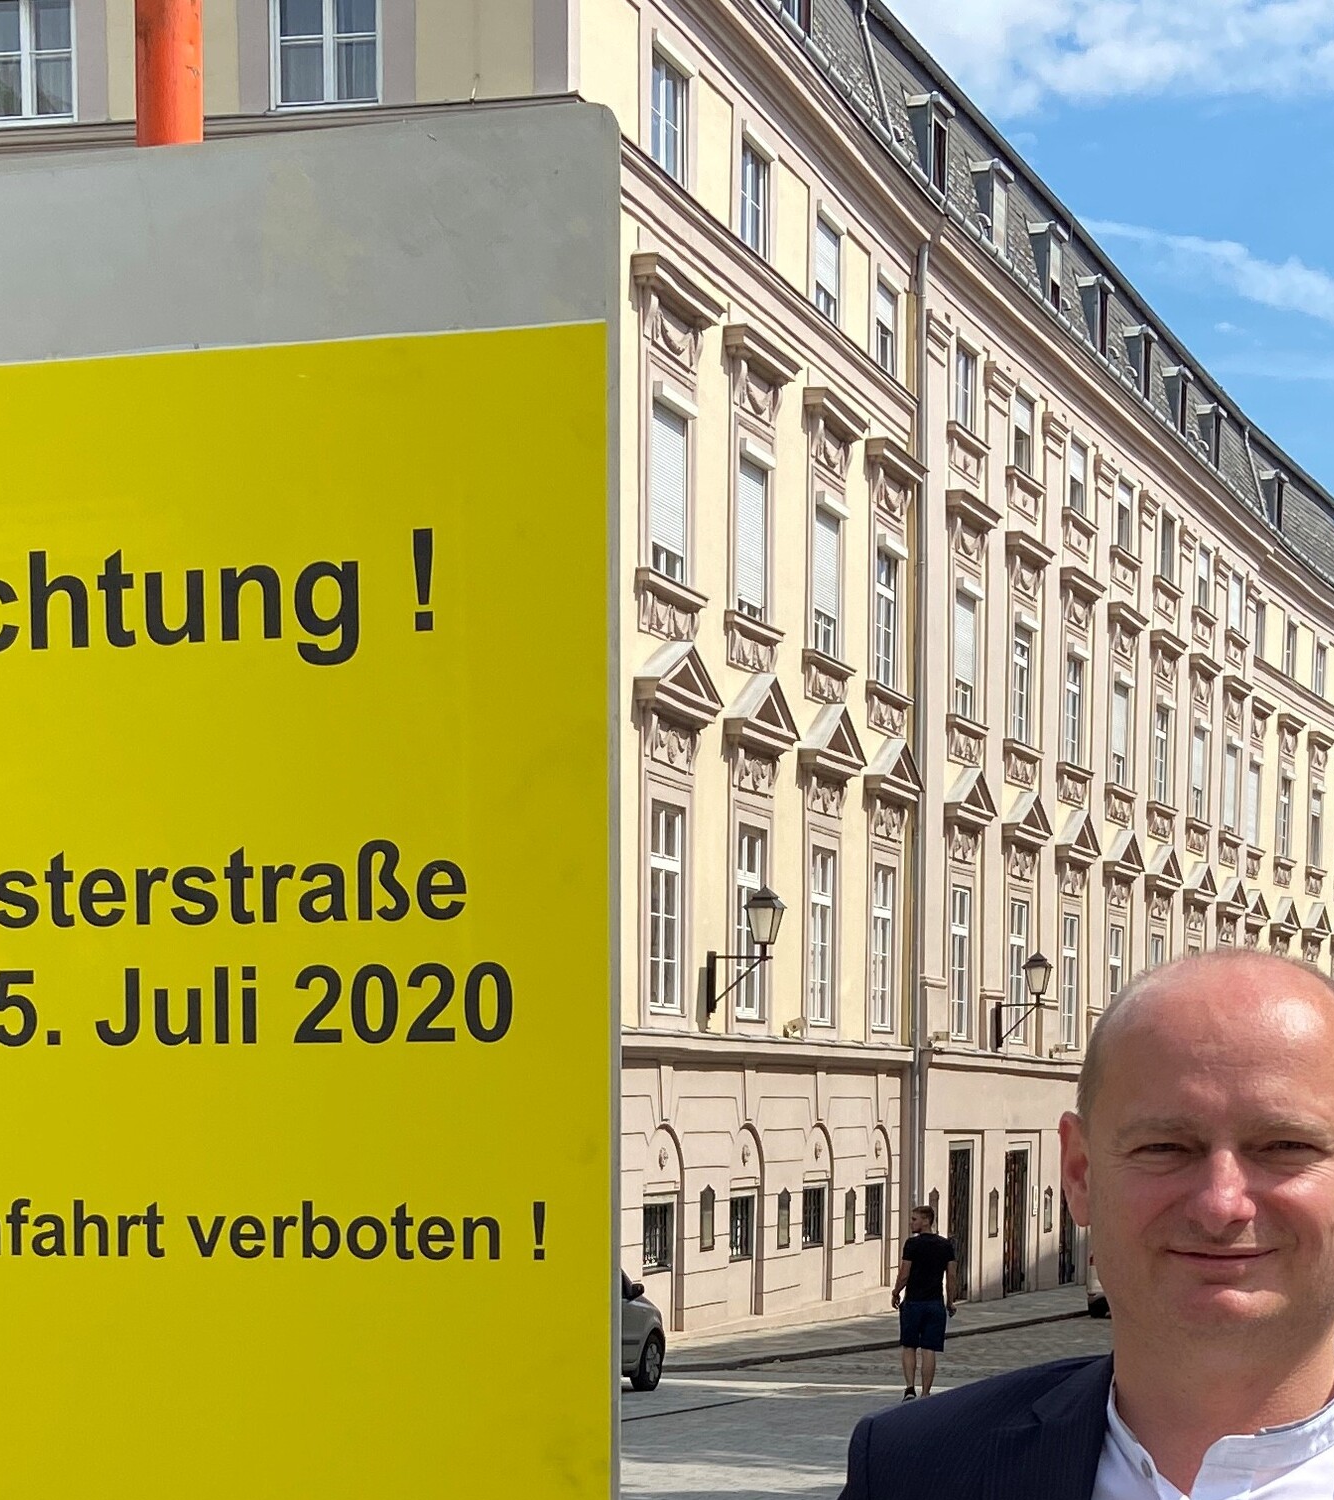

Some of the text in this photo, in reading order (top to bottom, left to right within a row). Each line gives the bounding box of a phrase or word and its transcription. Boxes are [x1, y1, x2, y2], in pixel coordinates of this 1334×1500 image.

[411, 527, 435, 632] !
[94, 964, 259, 1047] Juli
[293, 961, 515, 1045] 2020
[186, 1201, 502, 1261] verboten
[530, 1201, 548, 1261] !
